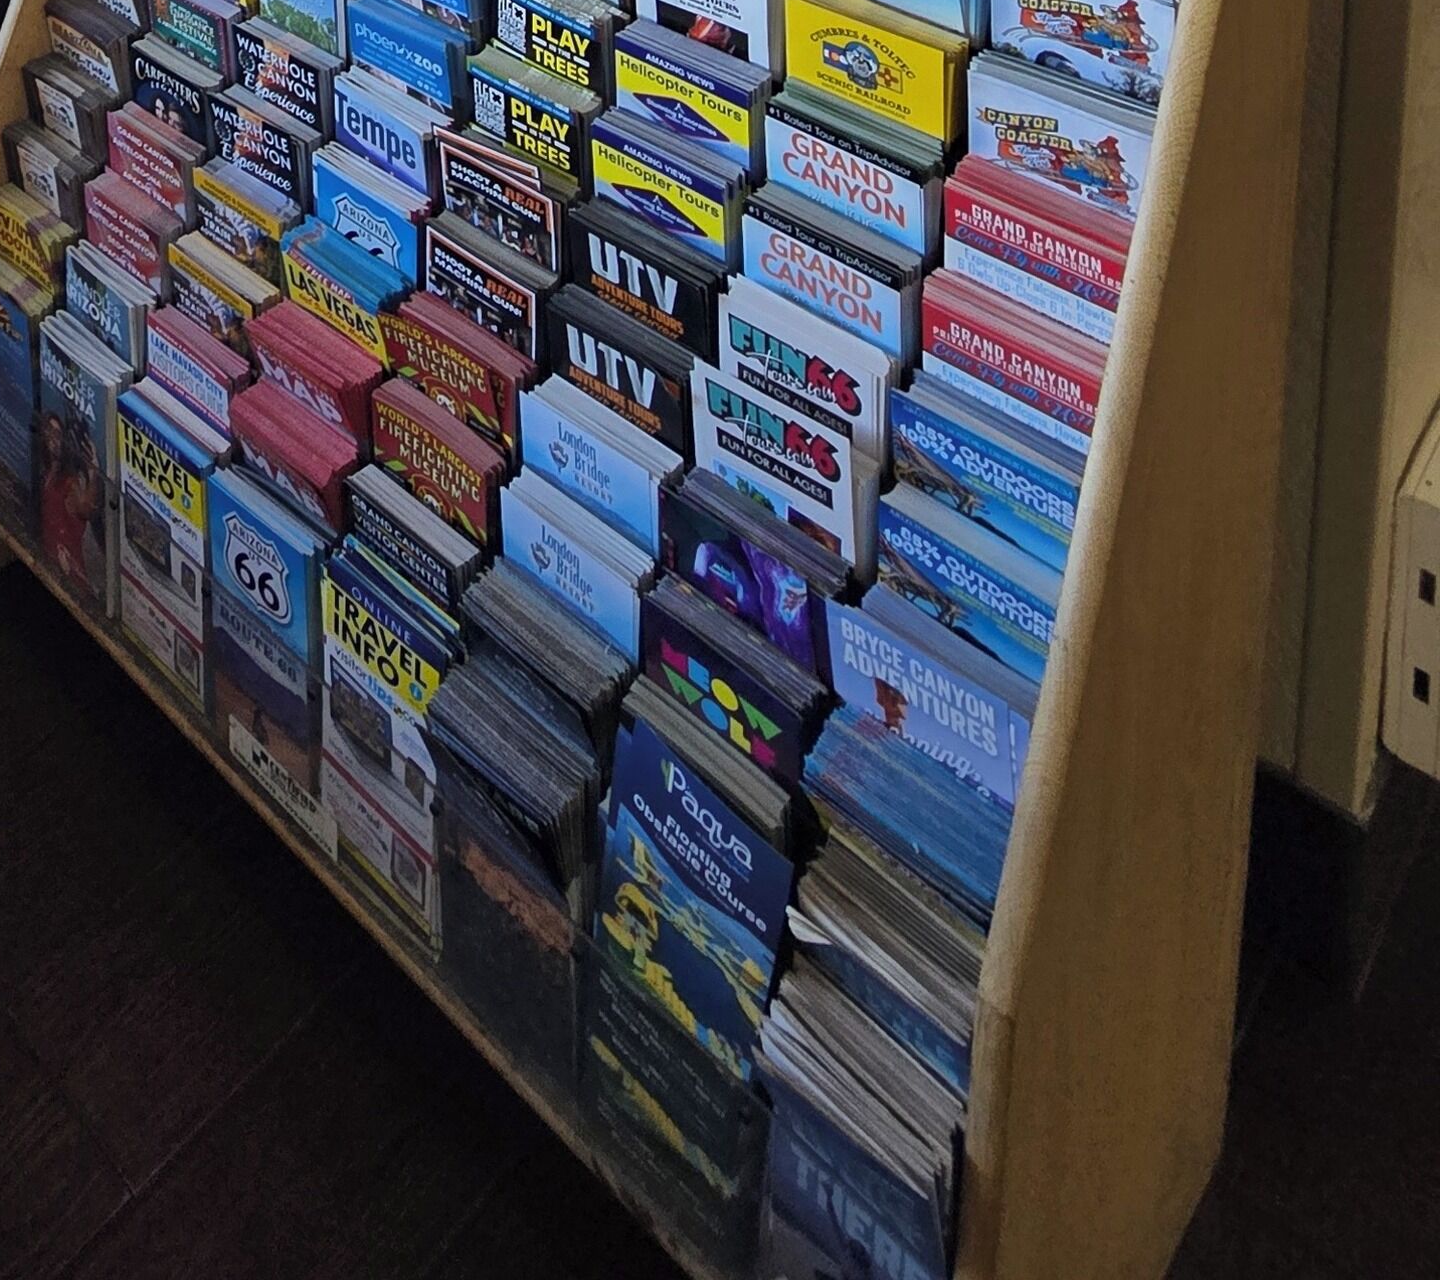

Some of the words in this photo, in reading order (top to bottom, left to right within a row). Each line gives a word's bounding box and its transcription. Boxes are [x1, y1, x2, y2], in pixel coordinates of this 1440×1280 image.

[236, 33, 315, 88] WATERHOLE
[532, 13, 590, 57] PLAY
[532, 44, 589, 85] TREES
[135, 58, 199, 114] CARPENTERS
[245, 72, 315, 124] Experience
[620, 55, 694, 99] Helicopter
[697, 90, 742, 121] Tours
[646, 53, 685, 77] AMAZING
[687, 71, 715, 90] VIEWS
[817, 70, 852, 92] SCENIC
[856, 84, 911, 116] RAILROAD
[335, 94, 416, 169] Tempe
[511, 98, 569, 142] PLAY
[513, 129, 571, 170] TREES
[784, 112, 812, 132] Rated
[815, 125, 836, 142] Tour
[855, 143, 912, 177] TripAdvisor
[987, 110, 1056, 130] CANYON
[997, 128, 1072, 150] COASTER
[450, 161, 491, 185] SHOOT
[505, 187, 545, 214] REAL
[451, 170, 510, 205] MACHINE
[599, 145, 672, 192] Helicopter
[676, 186, 719, 217] Tours
[782, 151, 906, 228] CANYON
[791, 132, 894, 194] GRAND
[588, 233, 678, 316] UTV
[770, 233, 872, 300] GRAND
[955, 209, 999, 238] PRIVATE
[1003, 231, 1043, 256] RAPTOR
[1049, 251, 1123, 290] ENCOUNTERS
[1033, 231, 1101, 272] CANYON
[289, 264, 319, 302] LAS
[322, 284, 378, 343] VEGAS
[761, 252, 882, 334] CANYON
[380, 315, 431, 341] WORLD'S
[729, 313, 806, 381] FUN
[384, 328, 486, 392] FIREFIGHTING
[407, 351, 471, 397] MUSEUM
[566, 323, 656, 409] UTV
[950, 322, 1005, 360] GRAND
[1011, 352, 1081, 398] CANYON
[135, 418, 180, 460] ONLINE
[768, 382, 790, 400] FOR
[792, 396, 812, 413] ALL
[813, 410, 848, 434] AGES!
[121, 419, 194, 498] TRAVEL
[558, 422, 596, 458] London
[575, 451, 610, 490] Bridge
[125, 445, 174, 501] INFO
[960, 446, 1075, 516] OUTDOORS
[235, 552, 279, 611] 66
[356, 516, 399, 558] VISITOR
[400, 552, 448, 599] CENTER
[332, 584, 427, 689] TRAVEL
[334, 612, 399, 687] INFO
[841, 618, 903, 670] BRYCE
[910, 657, 994, 729] CANYON
[844, 642, 998, 757] ADVENTURES
[634, 794, 701, 871] Obstacle
[705, 869, 766, 932] Course
[667, 815, 732, 889] Floating
